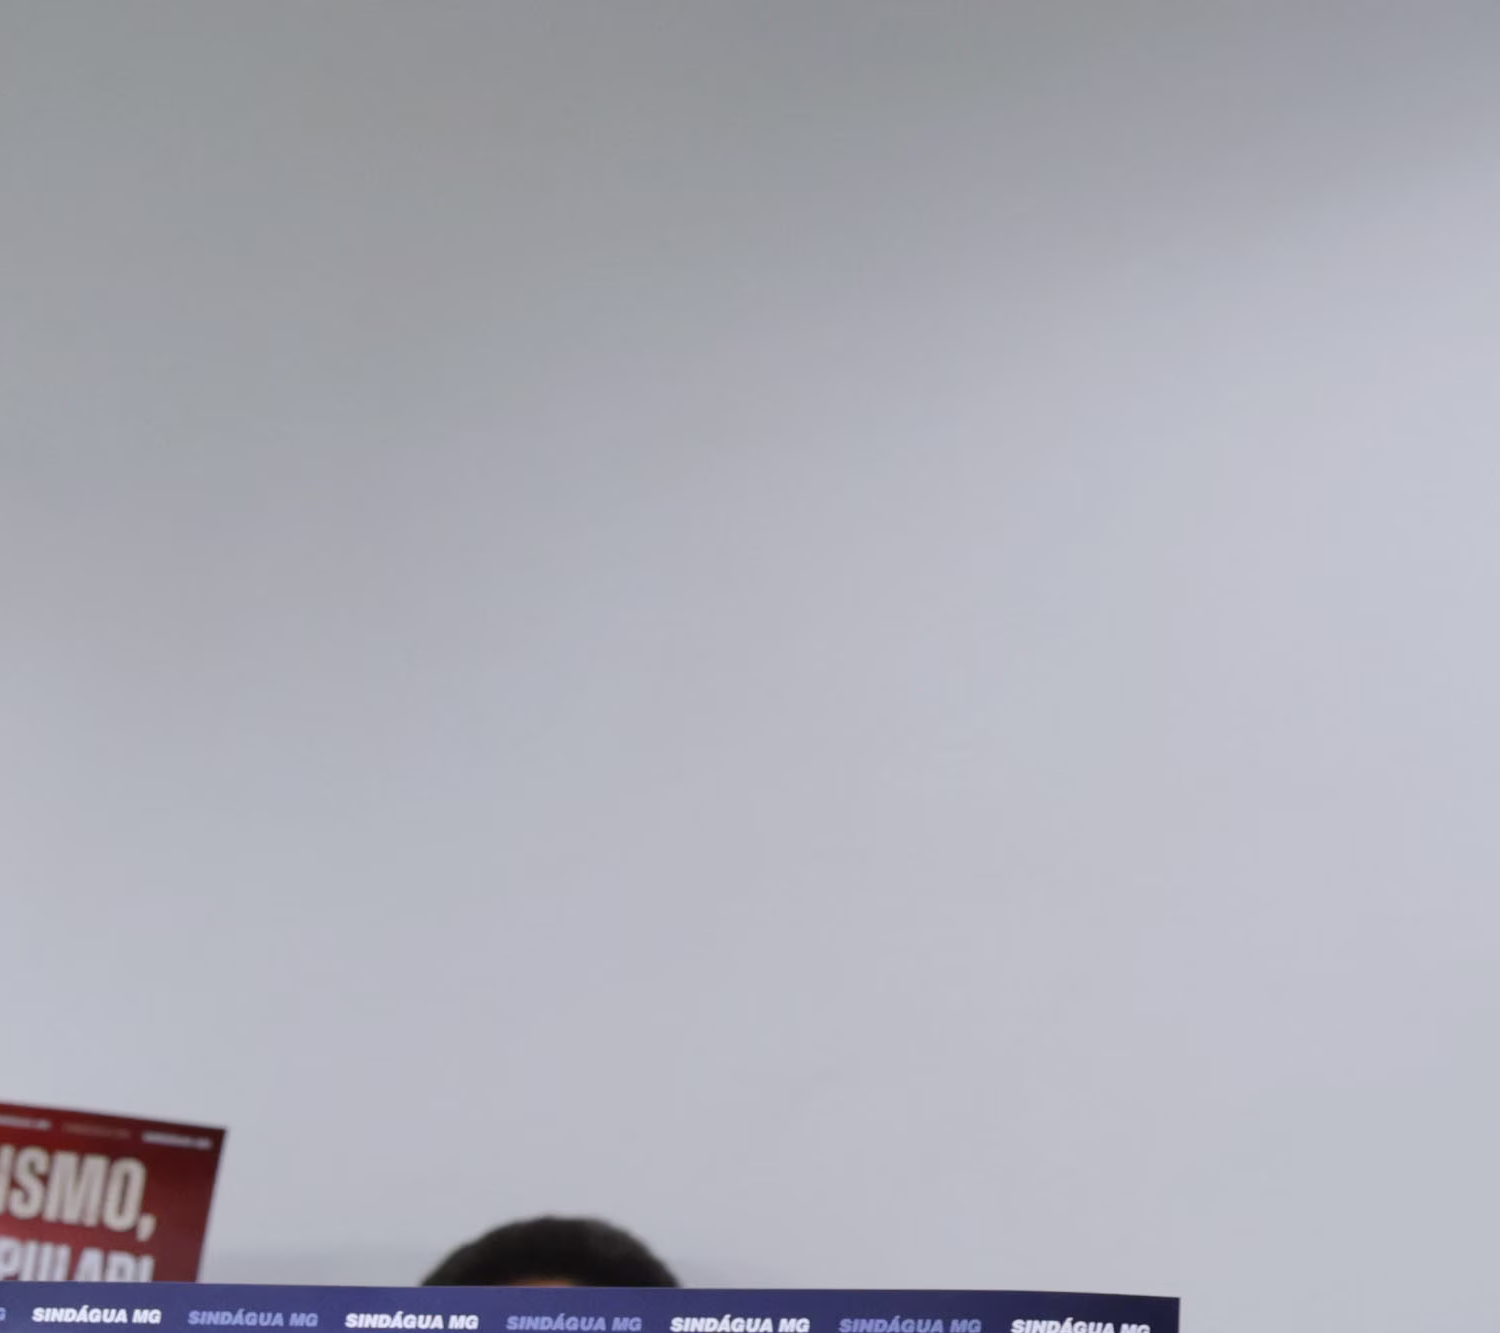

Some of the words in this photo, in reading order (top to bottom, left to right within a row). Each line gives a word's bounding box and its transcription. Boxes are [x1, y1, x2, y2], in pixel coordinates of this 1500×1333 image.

[32, 1305, 127, 1324] SINDÁGUA
[133, 1308, 161, 1324] MG
[346, 1311, 444, 1330] SINDÁGUA
[449, 1314, 478, 1330] MG
[671, 1316, 771, 1333] SINDÁGUA
[778, 1319, 810, 1333] MG
